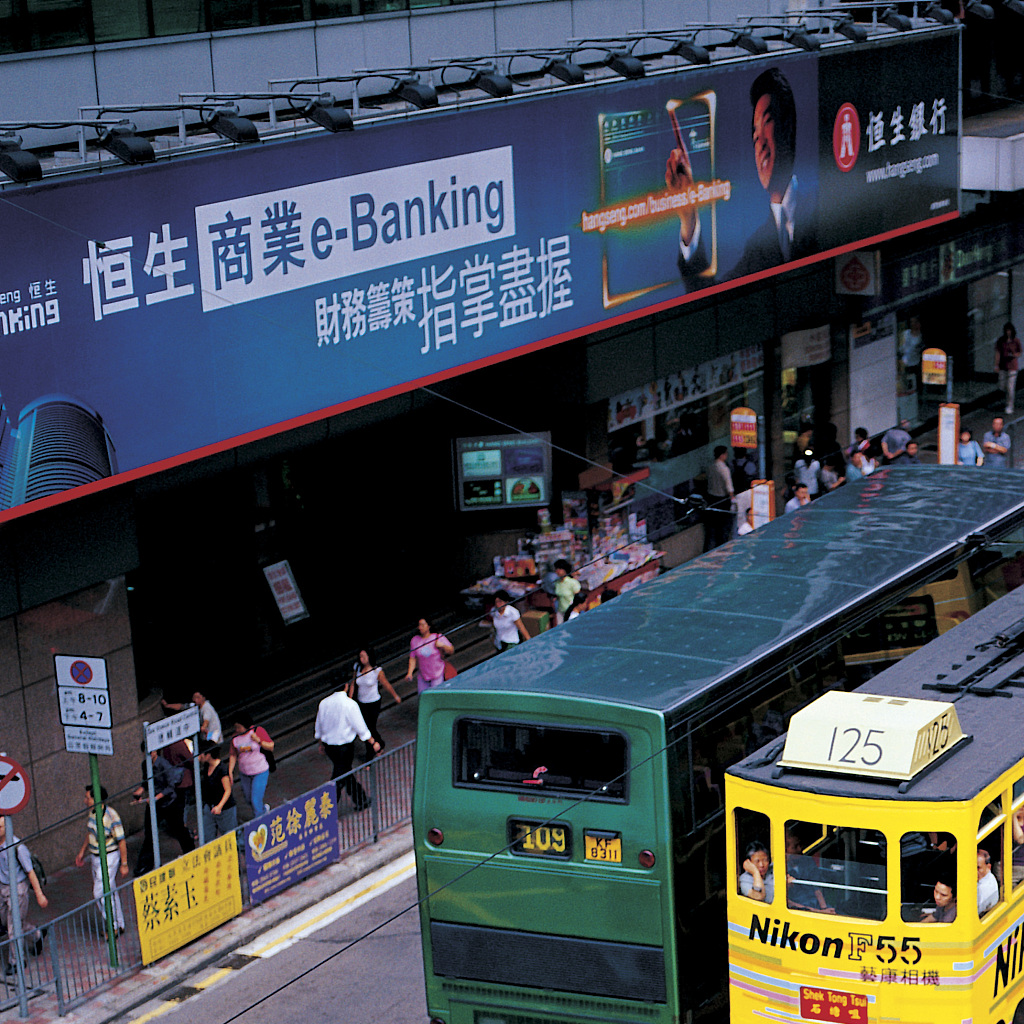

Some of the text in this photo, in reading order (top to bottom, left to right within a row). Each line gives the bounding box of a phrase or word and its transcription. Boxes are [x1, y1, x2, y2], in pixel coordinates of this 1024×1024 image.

[866, 98, 947, 152] 恒生銀行
[866, 153, 940, 183] www.hangseng.com
[82, 175, 504, 321] 恒生 商業 e-Banking
[29, 279, 57, 299] 恒生
[827, 726, 886, 766] 125
[522, 825, 566, 853] 109
[590, 847, 618, 860] 8311
[749, 914, 922, 965] Nikon F55
[803, 988, 868, 1008] Shek Tong Tsui
